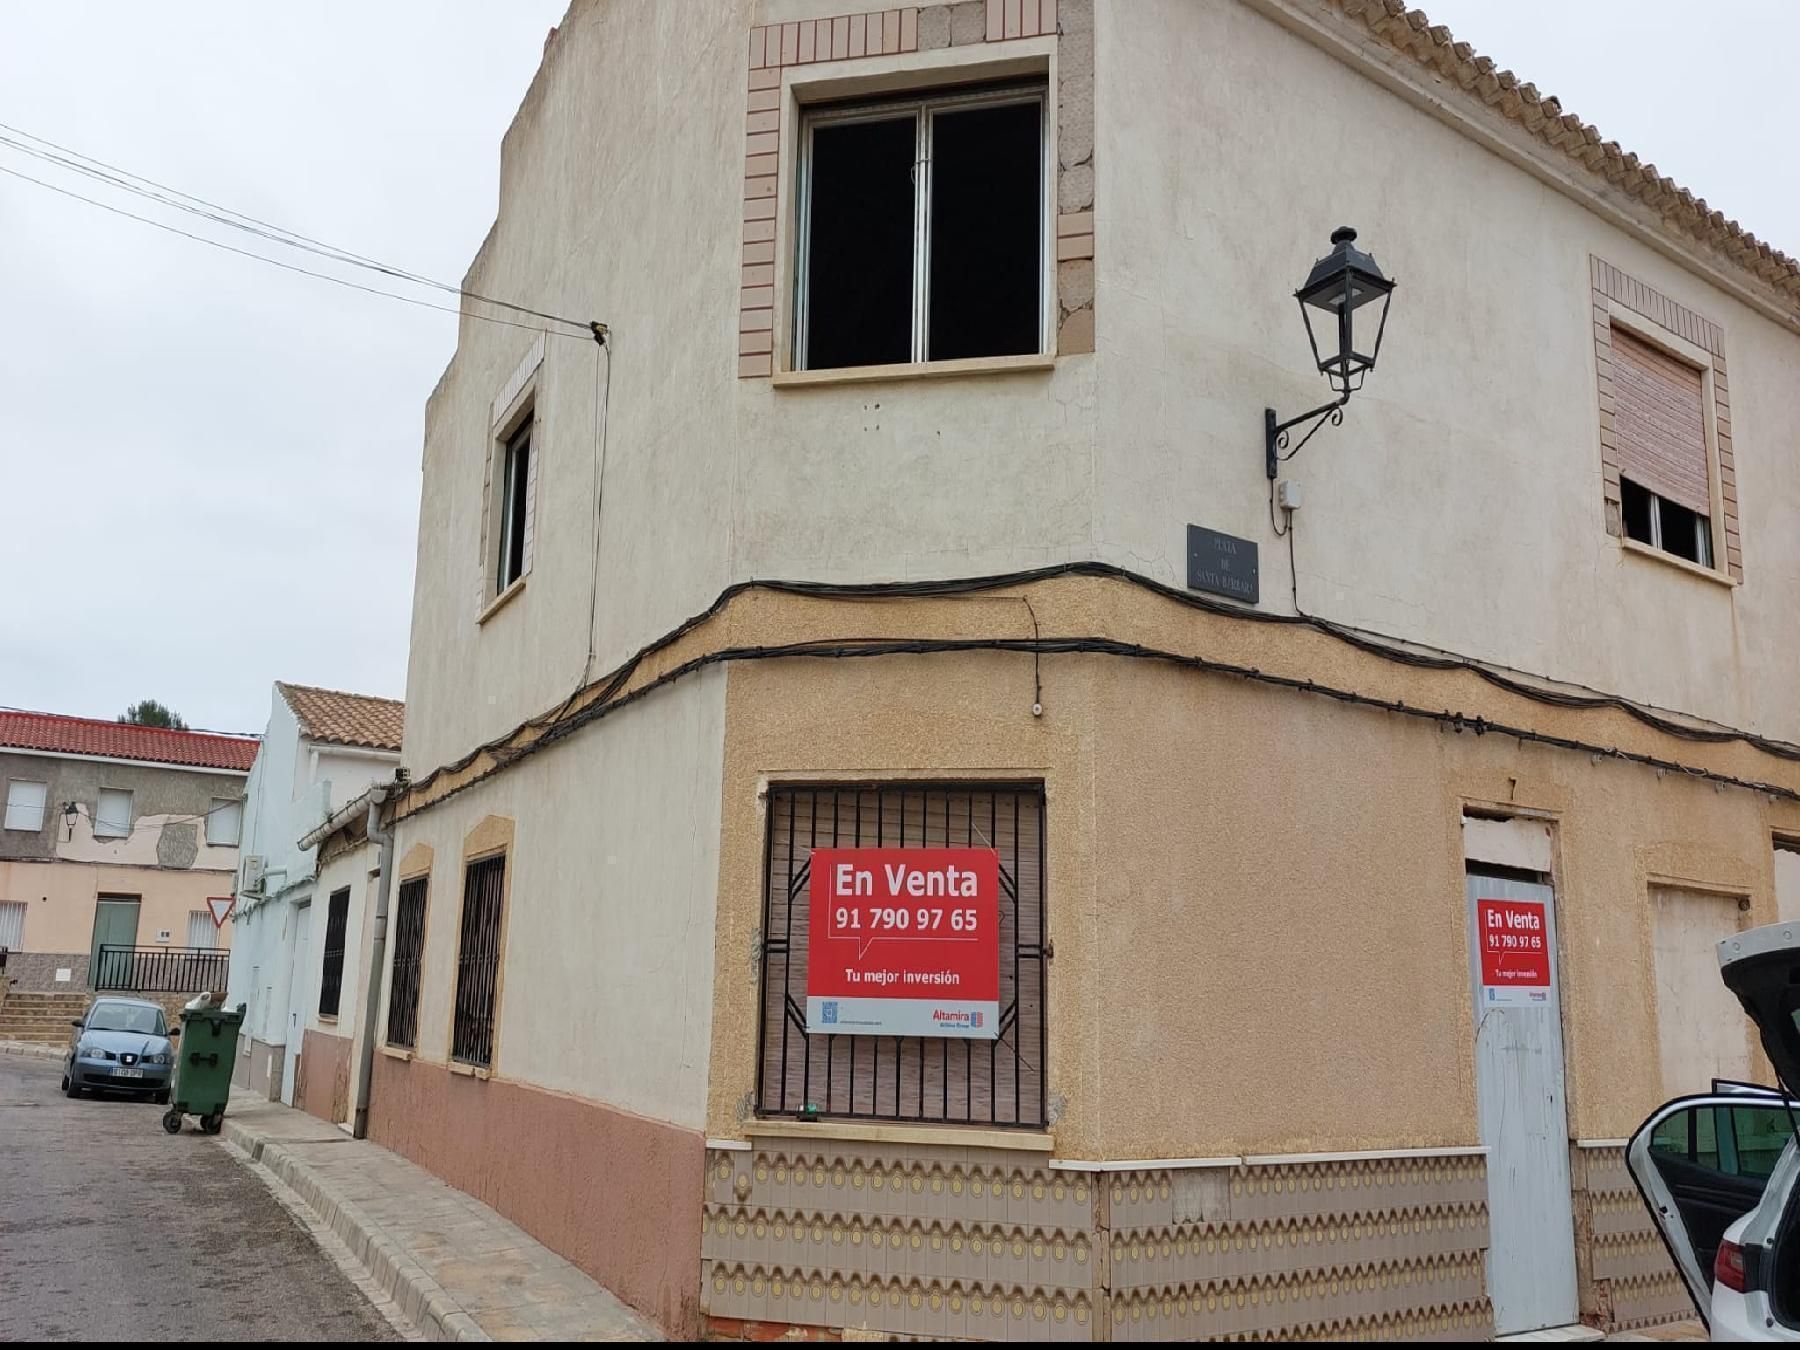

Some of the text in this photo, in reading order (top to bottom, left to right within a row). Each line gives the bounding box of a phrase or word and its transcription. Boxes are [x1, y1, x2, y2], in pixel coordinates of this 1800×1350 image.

[1214, 536, 1237, 555] PLAZA
[1220, 558, 1231, 572] DE
[1196, 568, 1220, 586] SANTA
[836, 864, 978, 897] En Venta
[836, 907, 978, 931] 91 790 97 65
[1487, 909, 1540, 929] En Venta
[1489, 934, 1541, 948] 91 790 97 65
[845, 968, 960, 986] Tu mejor inversión
[933, 1009, 970, 1022] Altamira
